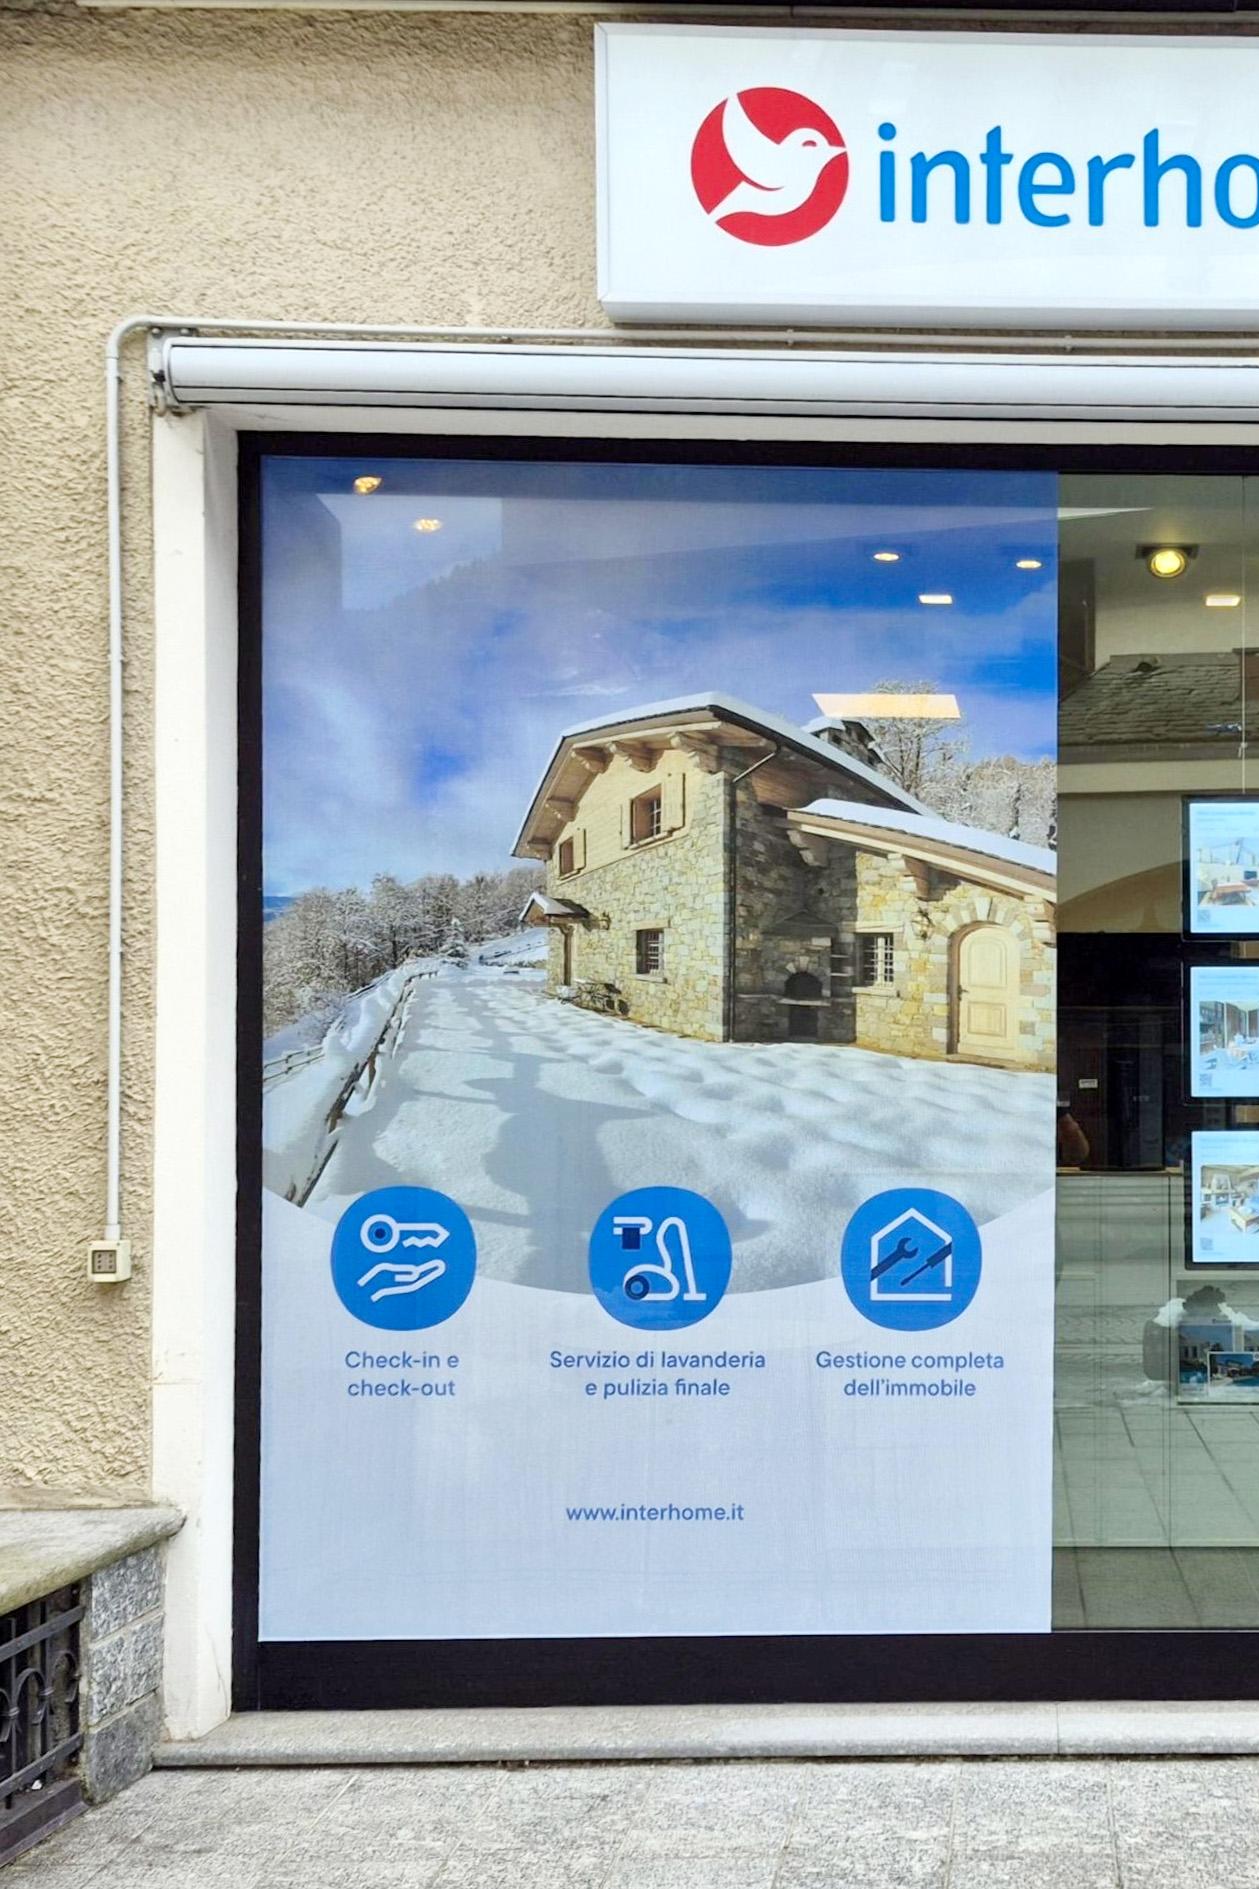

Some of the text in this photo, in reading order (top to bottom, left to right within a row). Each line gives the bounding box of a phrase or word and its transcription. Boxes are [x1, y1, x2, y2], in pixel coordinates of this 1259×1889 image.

[344, 1350, 460, 1369] Check-in e
[550, 1350, 766, 1369] Servizio di lavanderia
[815, 1350, 1005, 1373] Gestione completa
[347, 1378, 456, 1397] check-out
[584, 1377, 731, 1401] e pulizia finale
[843, 1378, 977, 1397] dell'immobile
[565, 1503, 745, 1521] www.interhome.it
